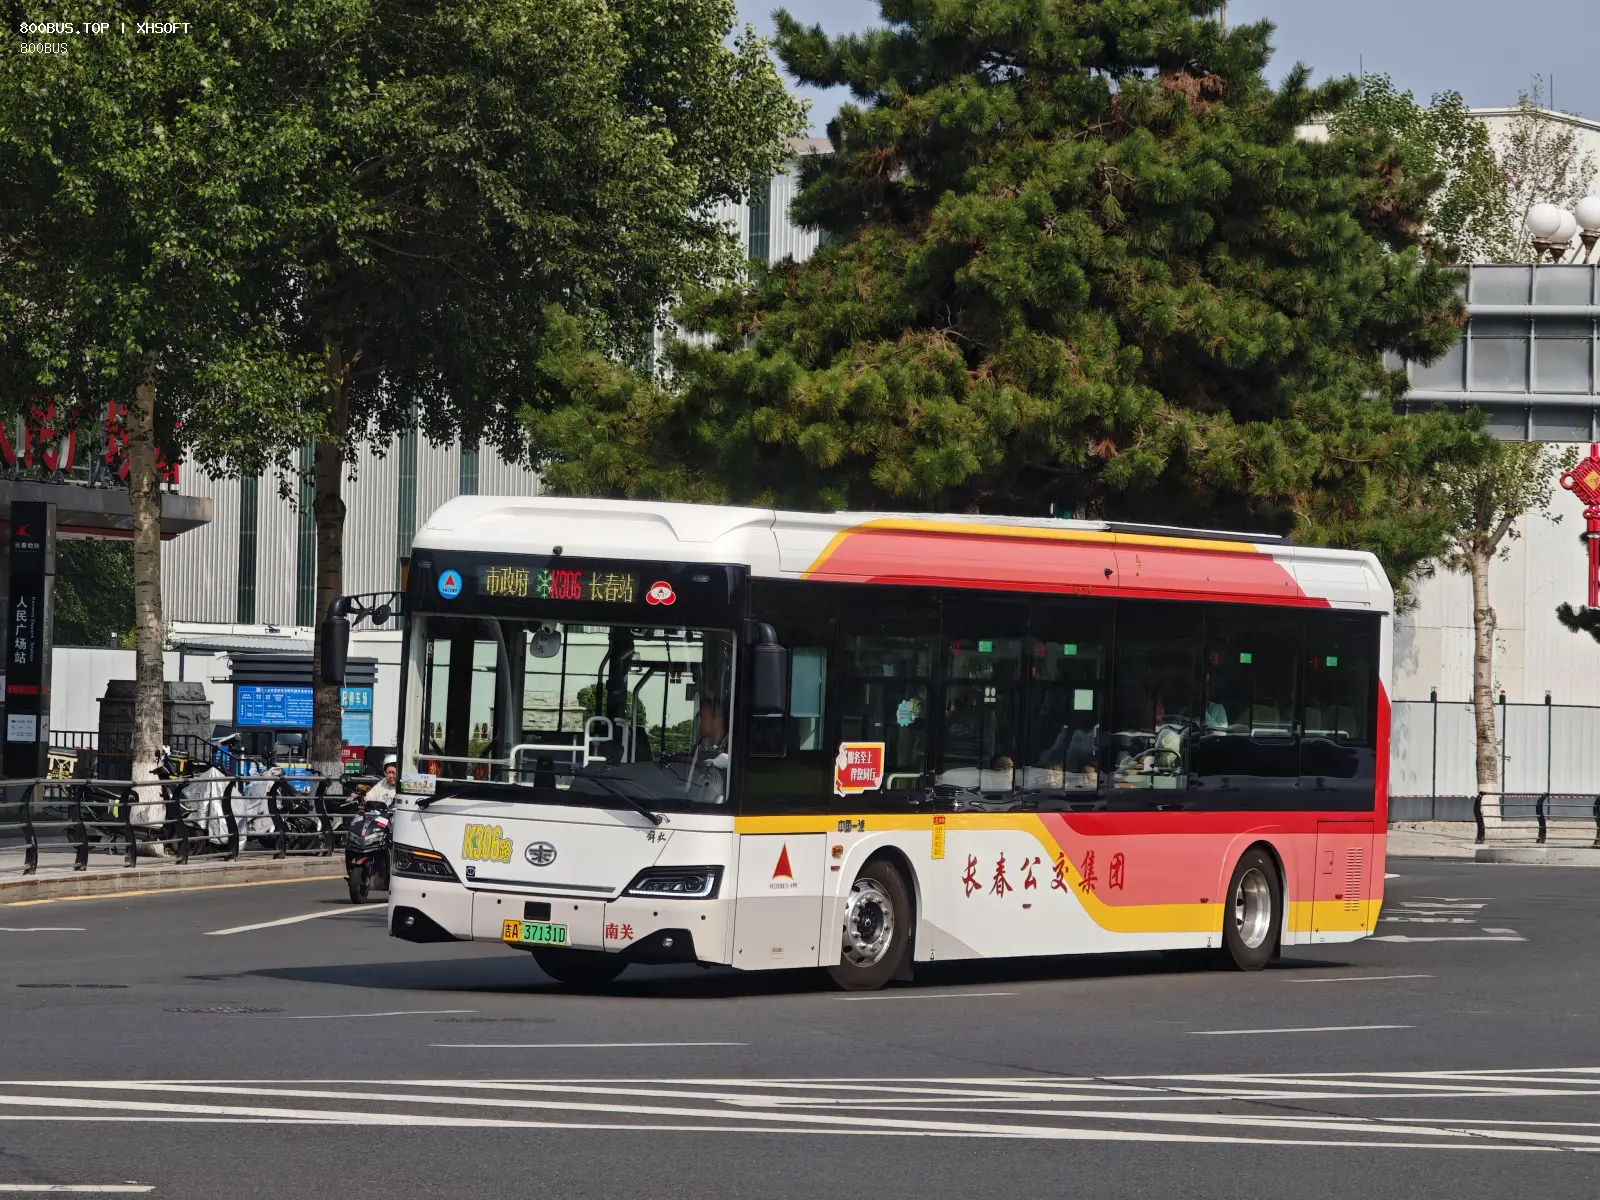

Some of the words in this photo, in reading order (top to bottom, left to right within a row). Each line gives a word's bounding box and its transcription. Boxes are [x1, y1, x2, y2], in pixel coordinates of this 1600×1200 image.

[486, 566, 530, 597] 市政府
[549, 569, 582, 601] K306
[588, 571, 634, 603] 长春站
[14, 596, 28, 664] 人民广场站
[961, 851, 1126, 899] 长春公交集团
[604, 922, 634, 940] 南关
